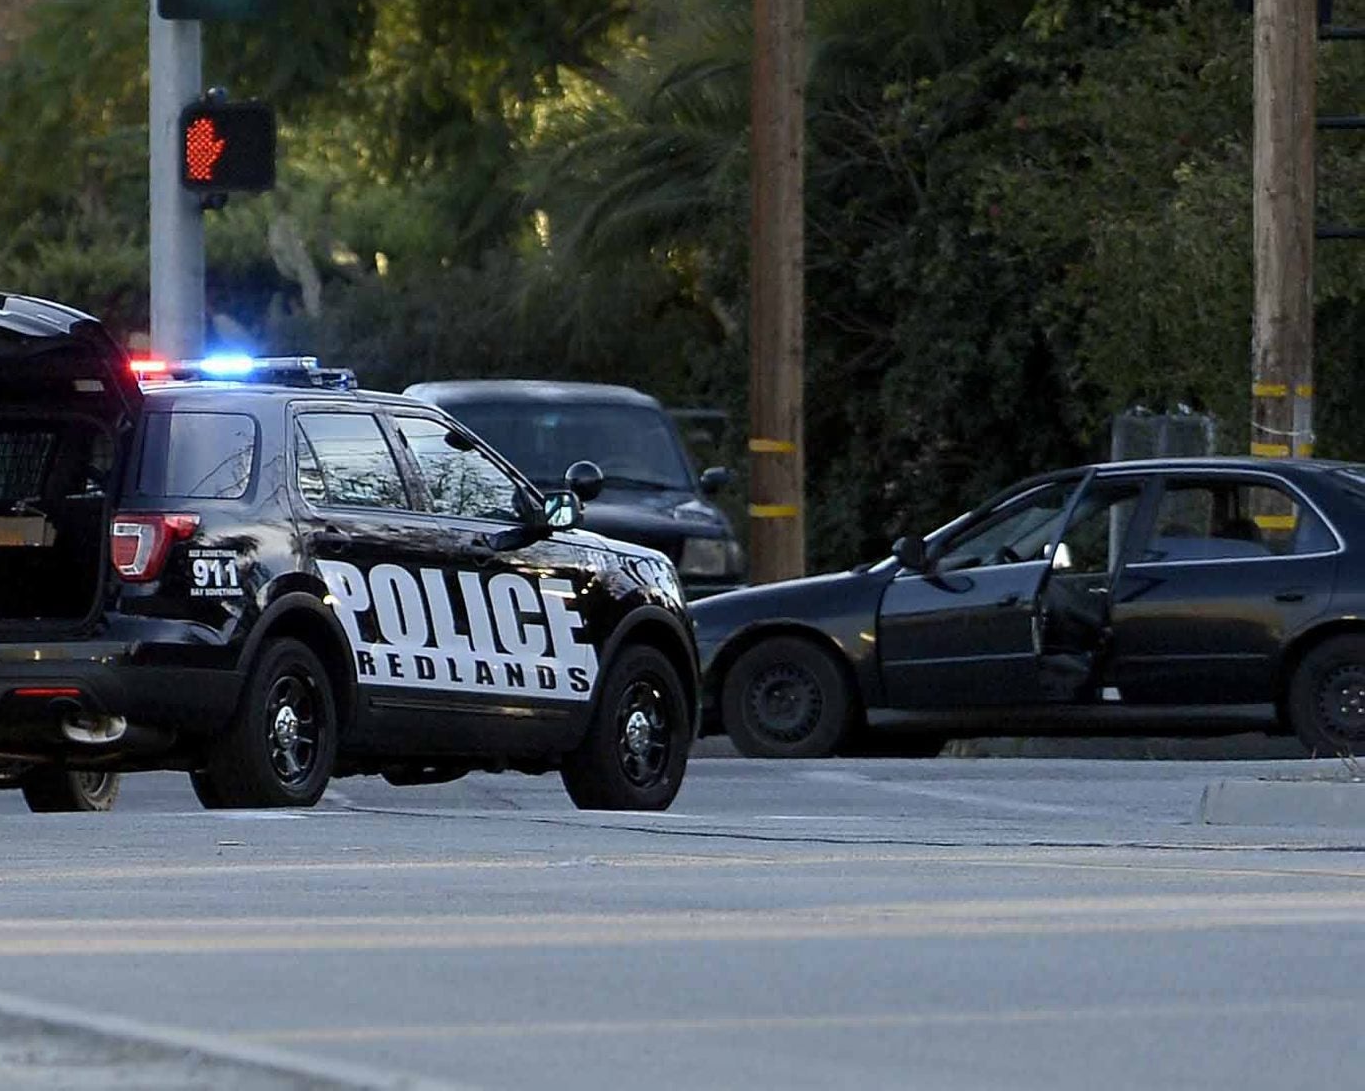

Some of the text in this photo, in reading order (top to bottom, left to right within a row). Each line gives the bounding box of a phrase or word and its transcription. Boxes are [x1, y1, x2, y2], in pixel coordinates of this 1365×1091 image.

[193, 559, 238, 587] 911
[315, 559, 595, 657] POLICE
[356, 650, 590, 692] REDLANDS
